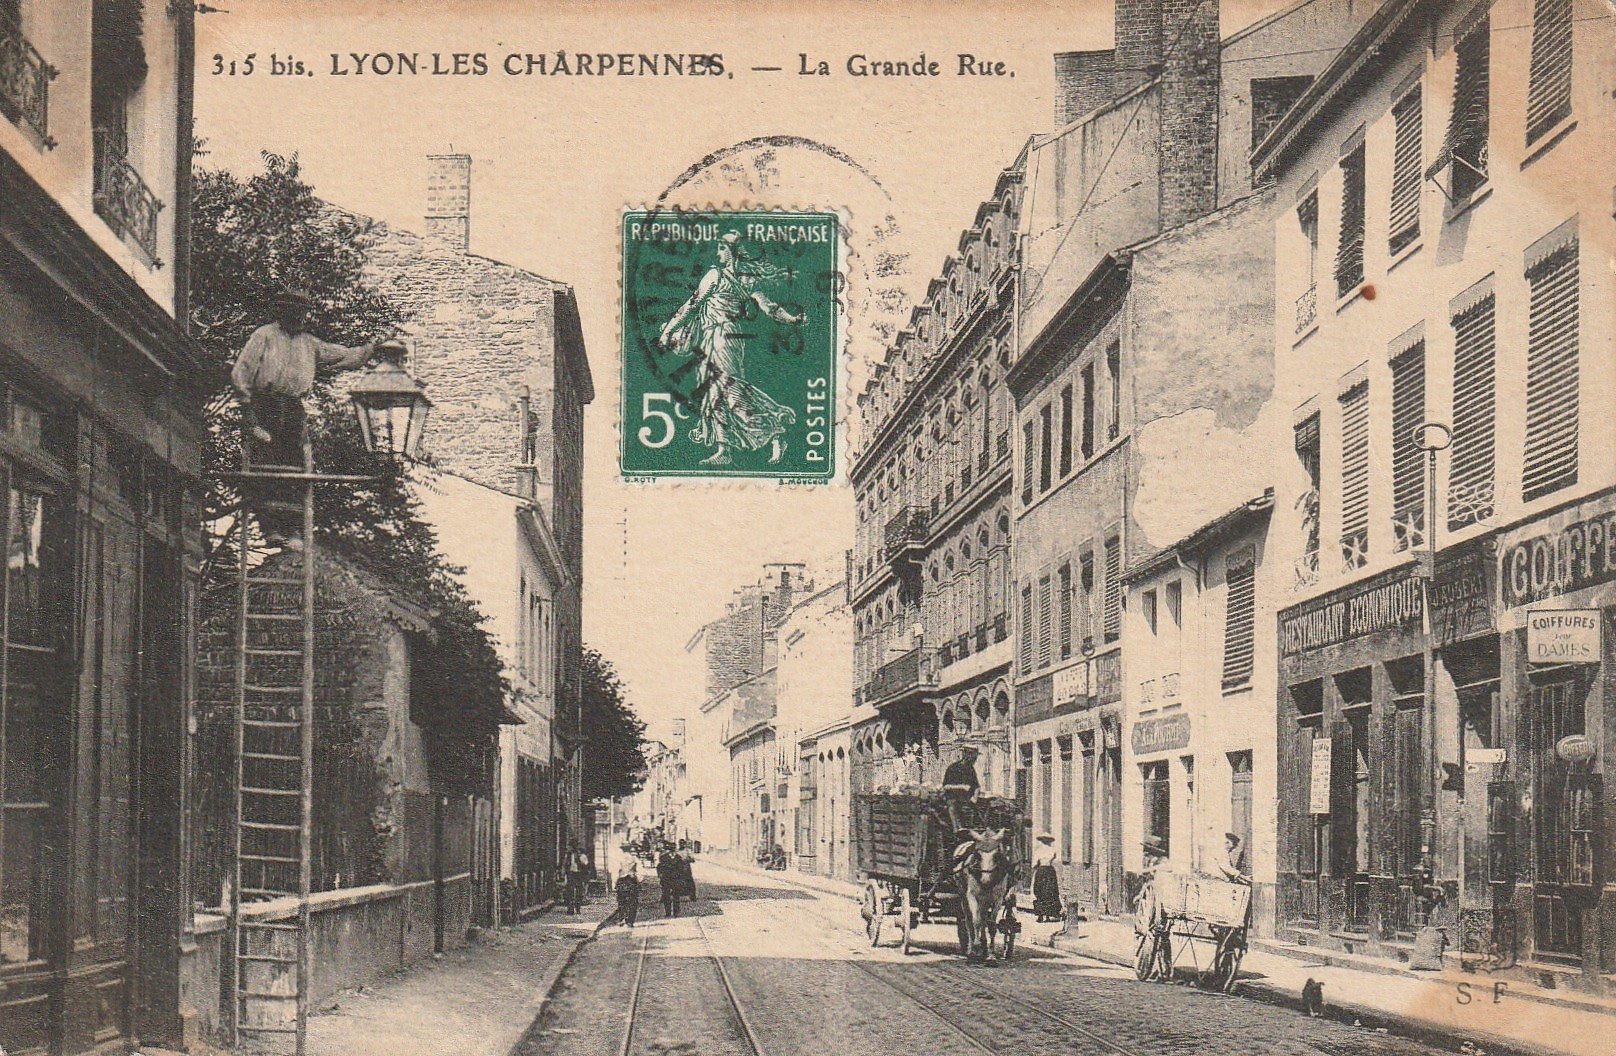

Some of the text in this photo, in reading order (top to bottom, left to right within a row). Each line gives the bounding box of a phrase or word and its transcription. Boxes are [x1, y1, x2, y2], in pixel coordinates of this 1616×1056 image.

[747, 224, 828, 244] FRANÇAISE
[806, 377, 827, 462] POSTES
[1284, 602, 1345, 654] RESTAURANT
[1349, 577, 1421, 635] ECONOMIQUE
[1533, 616, 1596, 630] COIFFURES
[1537, 643, 1591, 657] DAMES
